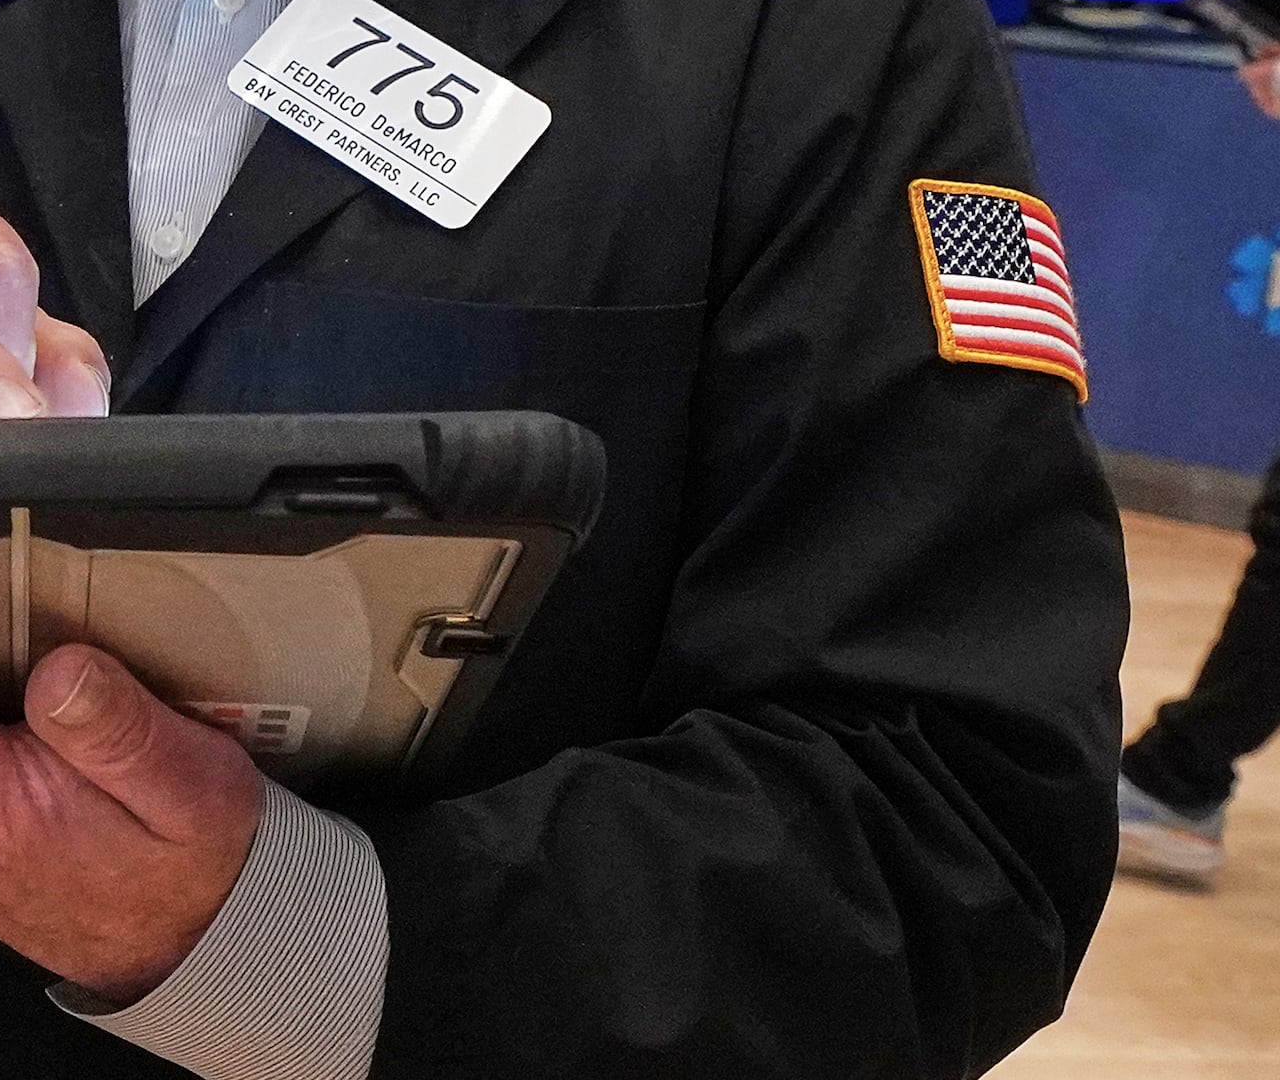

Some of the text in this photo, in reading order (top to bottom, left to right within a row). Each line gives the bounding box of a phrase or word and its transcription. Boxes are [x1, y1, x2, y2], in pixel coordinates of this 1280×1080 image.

[283, 60, 457, 175] FEDERICO DeMARCO
[326, 17, 480, 130] 775
[244, 77, 277, 102] BAY
[277, 98, 325, 132] CREST
[409, 181, 440, 207] LLC
